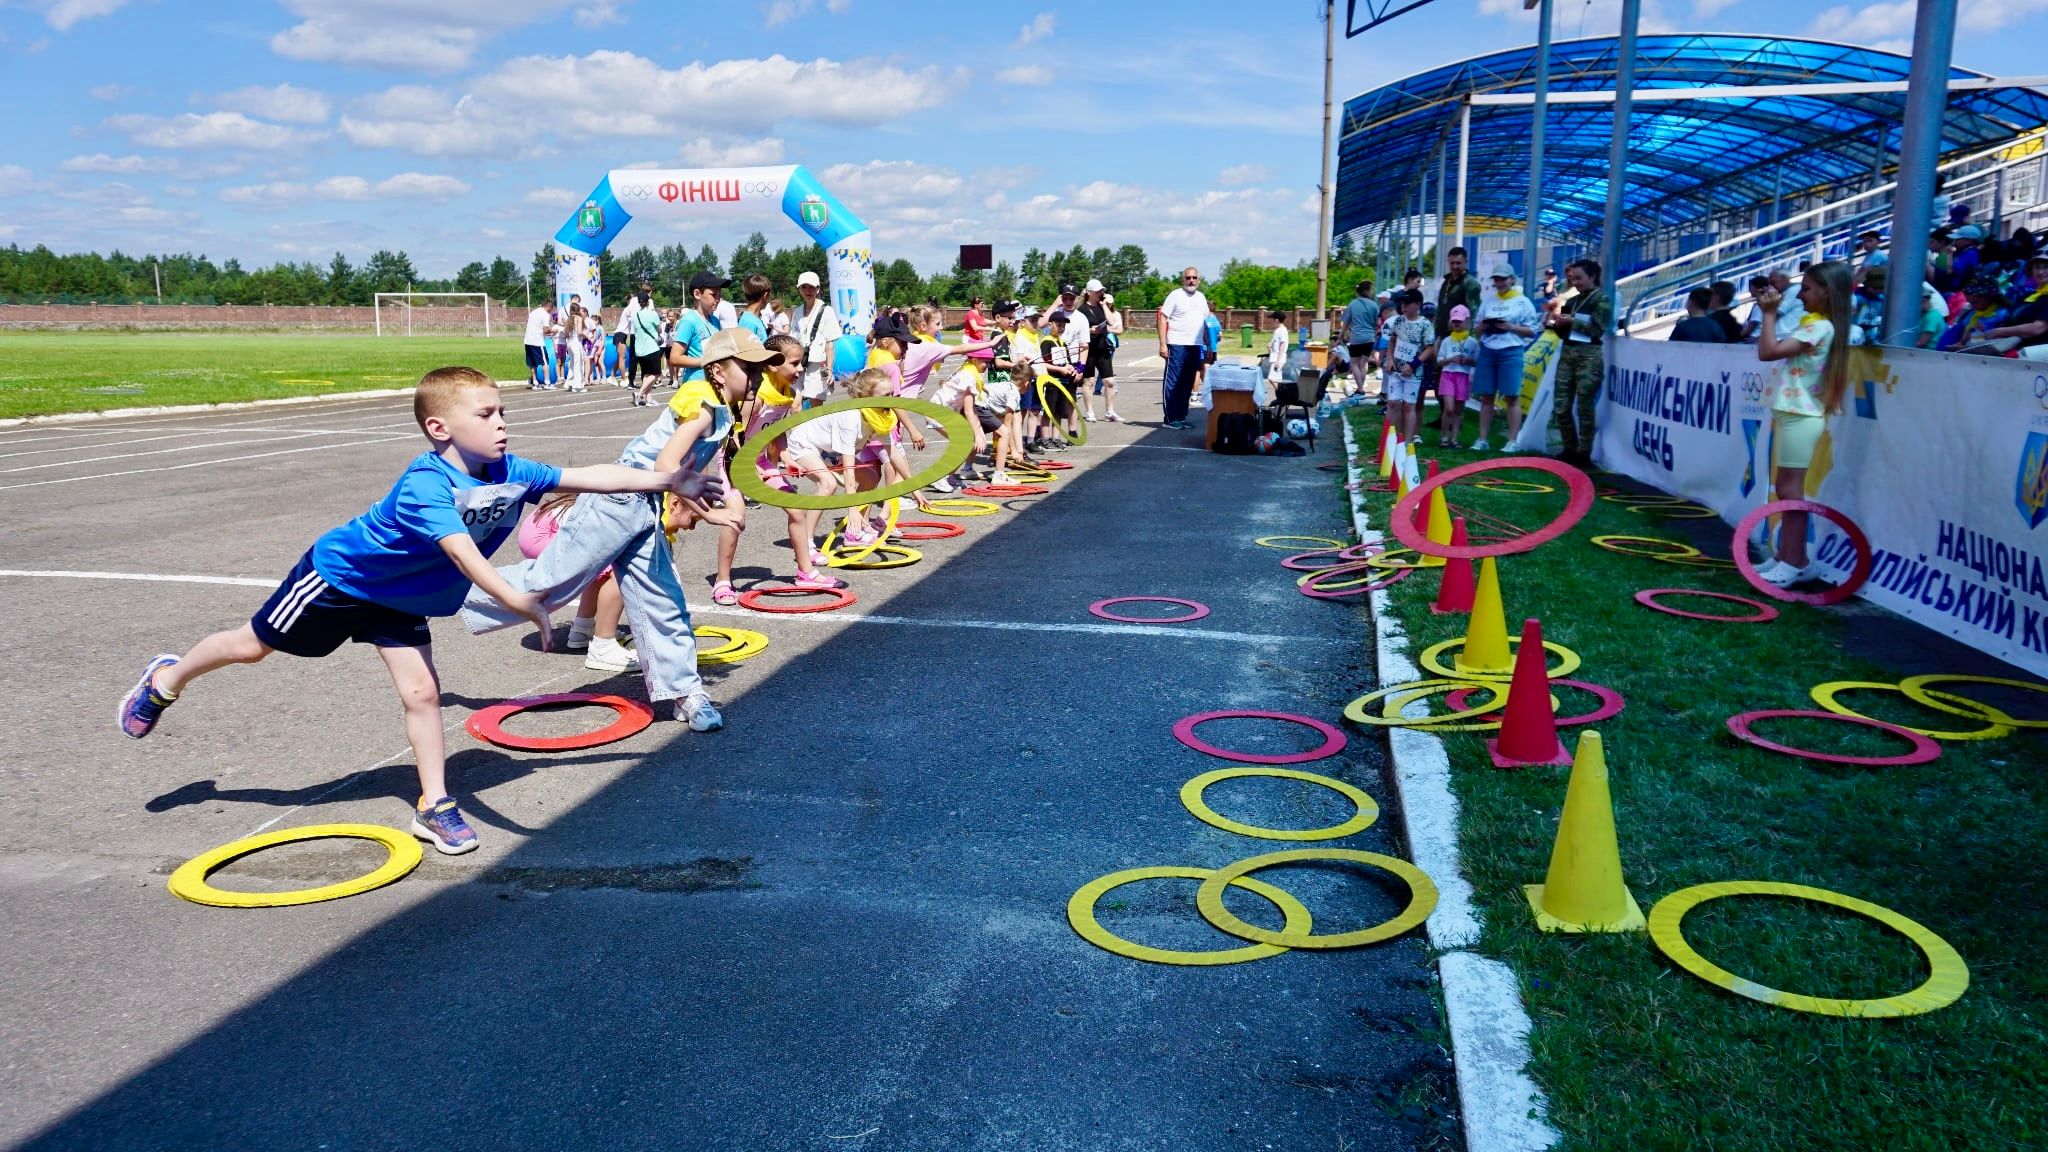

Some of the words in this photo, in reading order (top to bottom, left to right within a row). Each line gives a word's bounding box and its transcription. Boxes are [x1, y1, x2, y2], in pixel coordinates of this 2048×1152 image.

[658, 179, 741, 203] ФІНІШ
[1608, 363, 1731, 435] ОЛІМПІЙСЬКИЙ
[1633, 418, 1674, 472] ДЕНЬ
[1816, 533, 2015, 640] ОЛІПІЙСЬКИЙ
